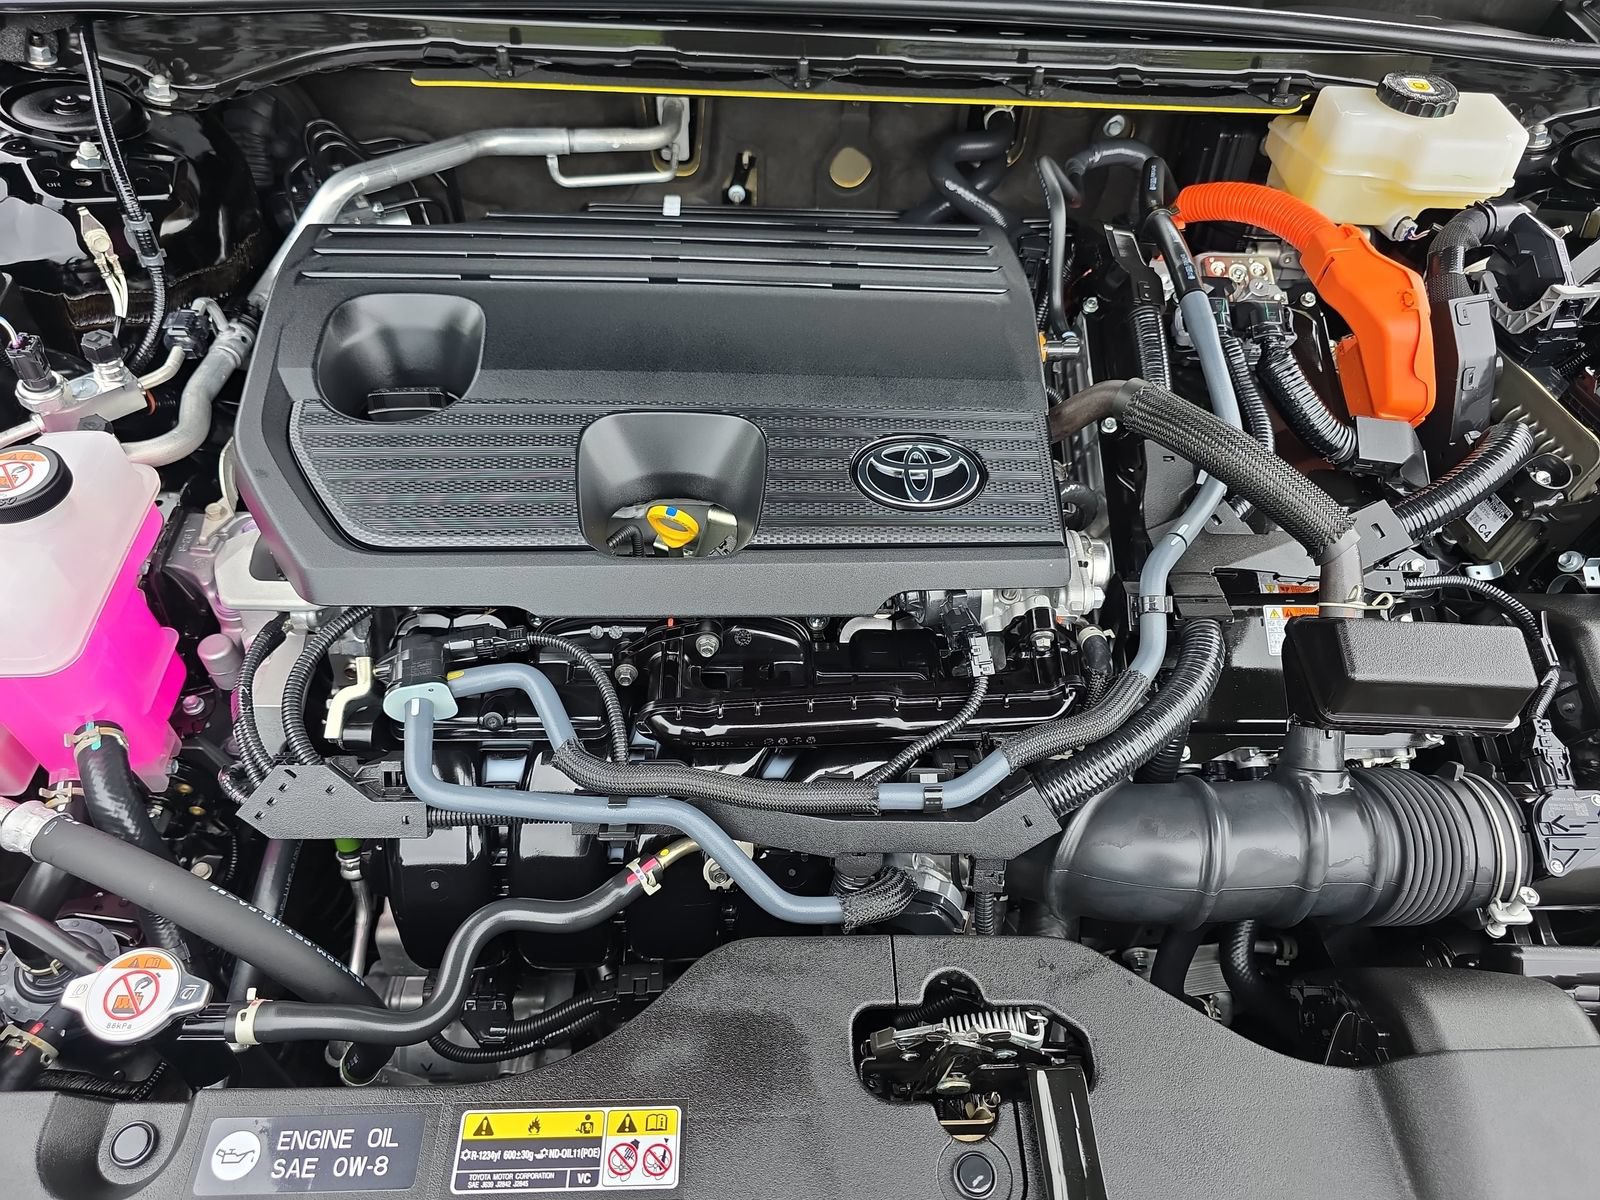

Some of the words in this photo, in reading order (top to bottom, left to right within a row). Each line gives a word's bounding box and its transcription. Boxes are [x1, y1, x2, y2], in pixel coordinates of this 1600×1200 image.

[1478, 523, 1492, 539] C4
[277, 1129, 355, 1150] ENGINE
[367, 1128, 399, 1148] OIL
[470, 1151, 502, 1162] R-1234yf
[503, 1149, 534, 1162] 600±30g
[549, 1147, 600, 1159] ND-OIL11(POE)
[271, 1157, 319, 1179] SAE
[333, 1155, 389, 1178] 0W-8
[469, 1173, 491, 1181] TOYOTA
[515, 1172, 554, 1180] CORPORATION
[577, 1172, 592, 1184] VC
